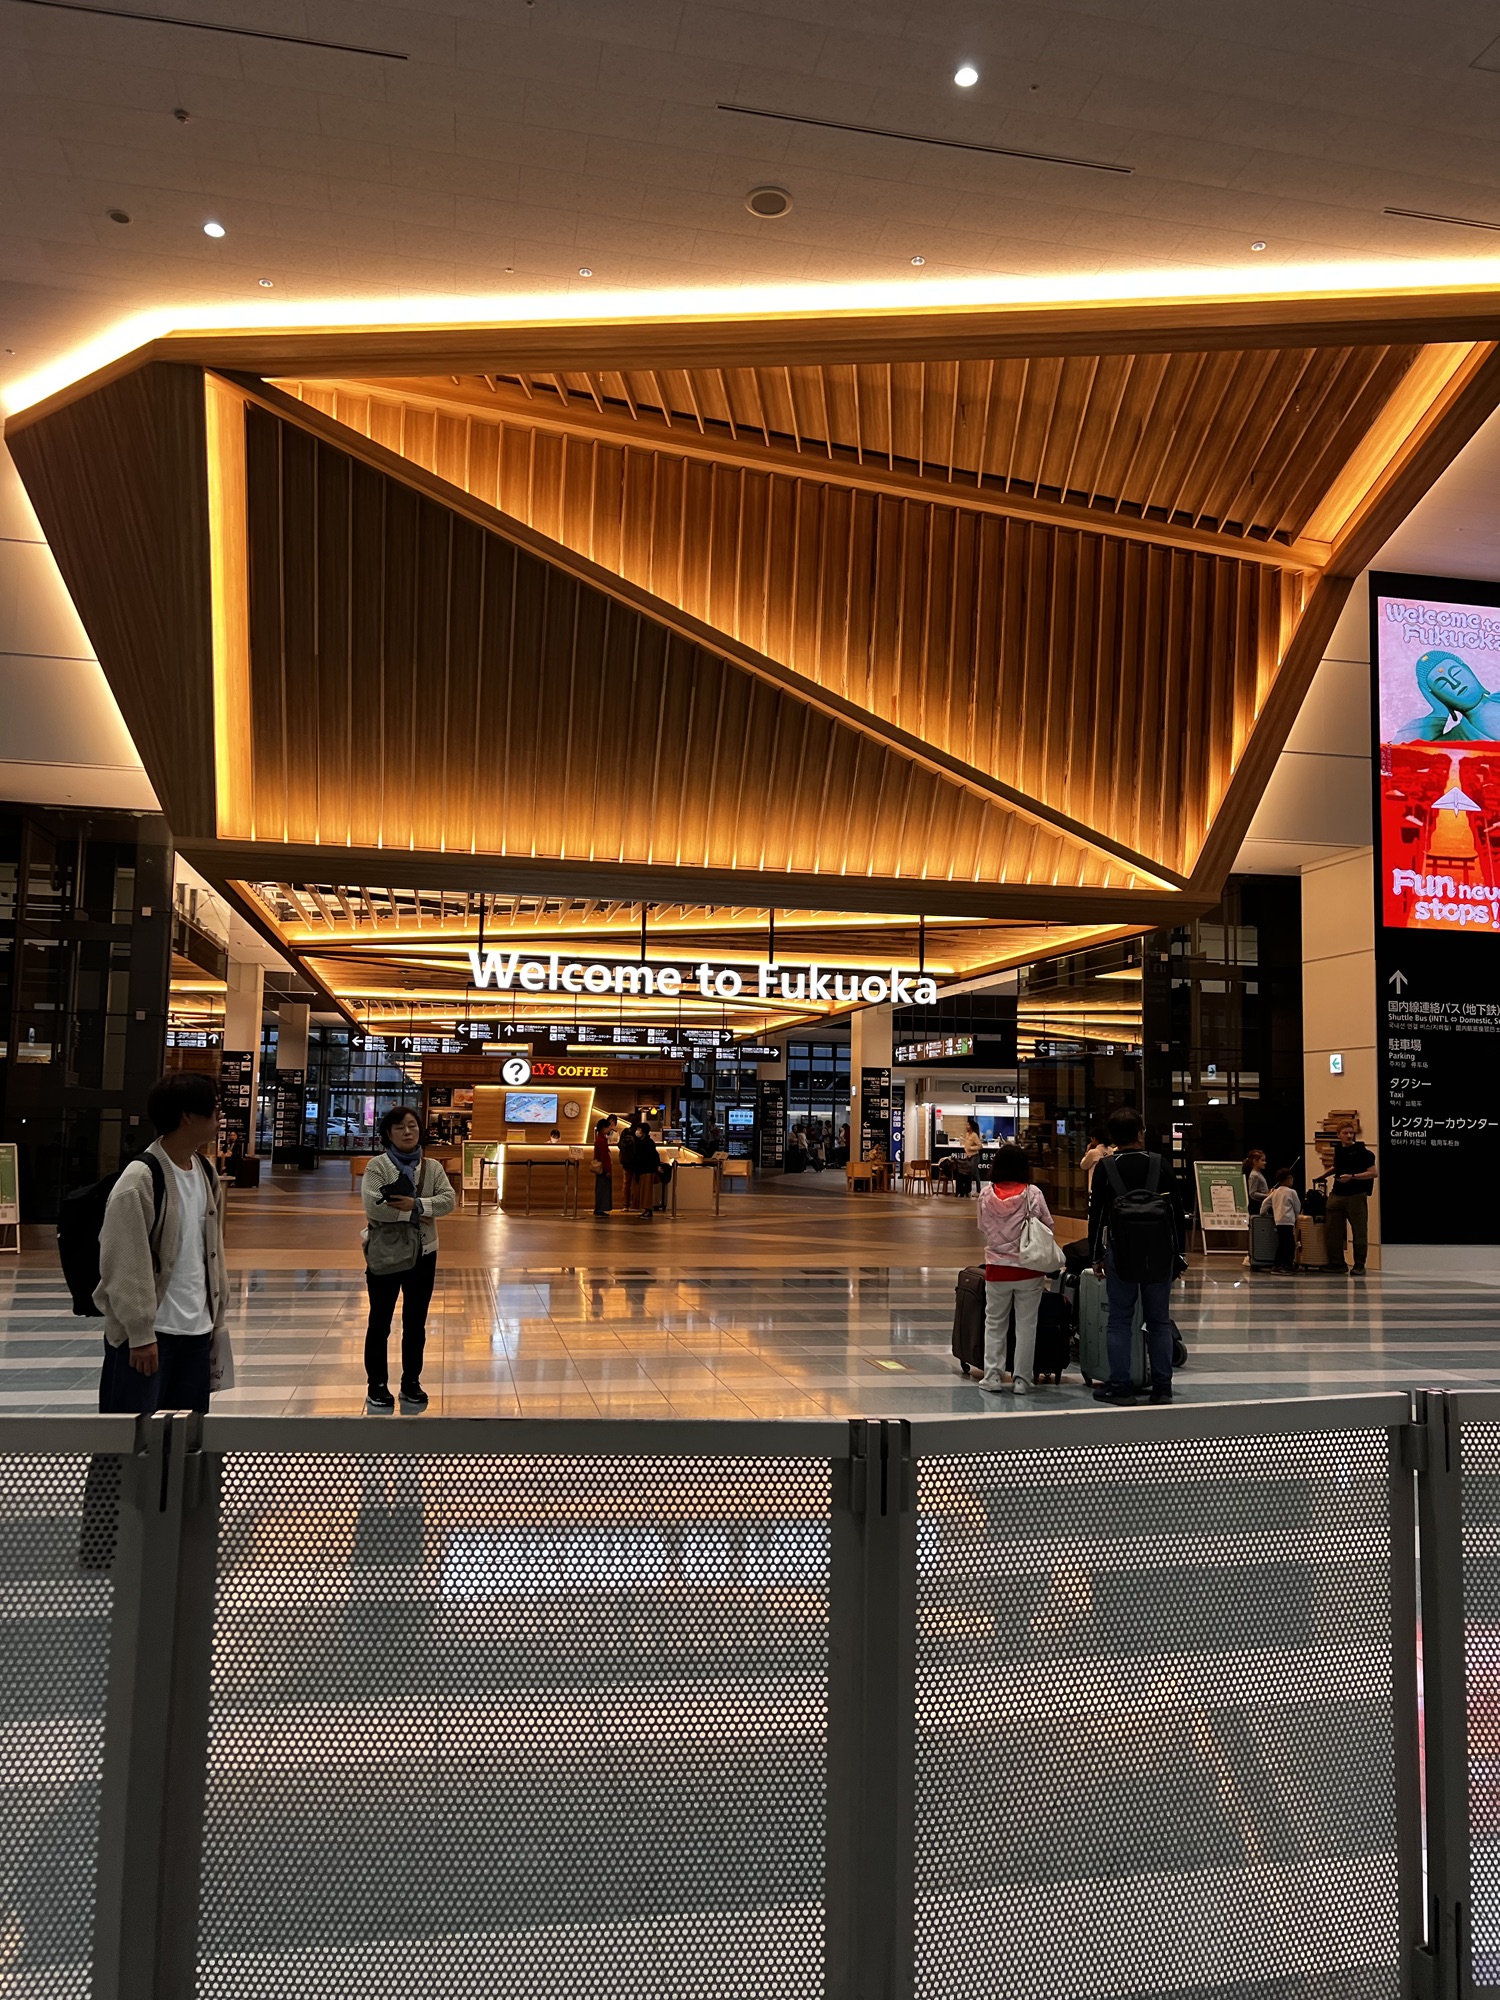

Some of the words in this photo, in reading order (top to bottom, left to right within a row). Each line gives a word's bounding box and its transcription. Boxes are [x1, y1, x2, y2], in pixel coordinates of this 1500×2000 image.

[1385, 603, 1482, 629] Welcome
[1483, 618, 1500, 632] to
[1392, 868, 1456, 898] Fun
[468, 951, 682, 995] Welcome
[696, 963, 742, 997] to
[758, 963, 937, 1004] Fukuoka
[1388, 1013, 1413, 1022] Shuttle
[1415, 1014, 1428, 1022] Bus
[1459, 1016, 1493, 1025] Domestic,
[1388, 1038, 1422, 1051] 駐車場
[1388, 1052, 1415, 1061] Parking
[531, 1063, 555, 1076] LY'S
[557, 1065, 608, 1077] COFFEE
[961, 1082, 1016, 1096] Currency
[1390, 1078, 1432, 1089] タクシー
[1391, 1116, 1499, 1130] レンタカーカウンター
[1390, 1129, 1402, 1137] Car
[1404, 1130, 1427, 1138] Rental
